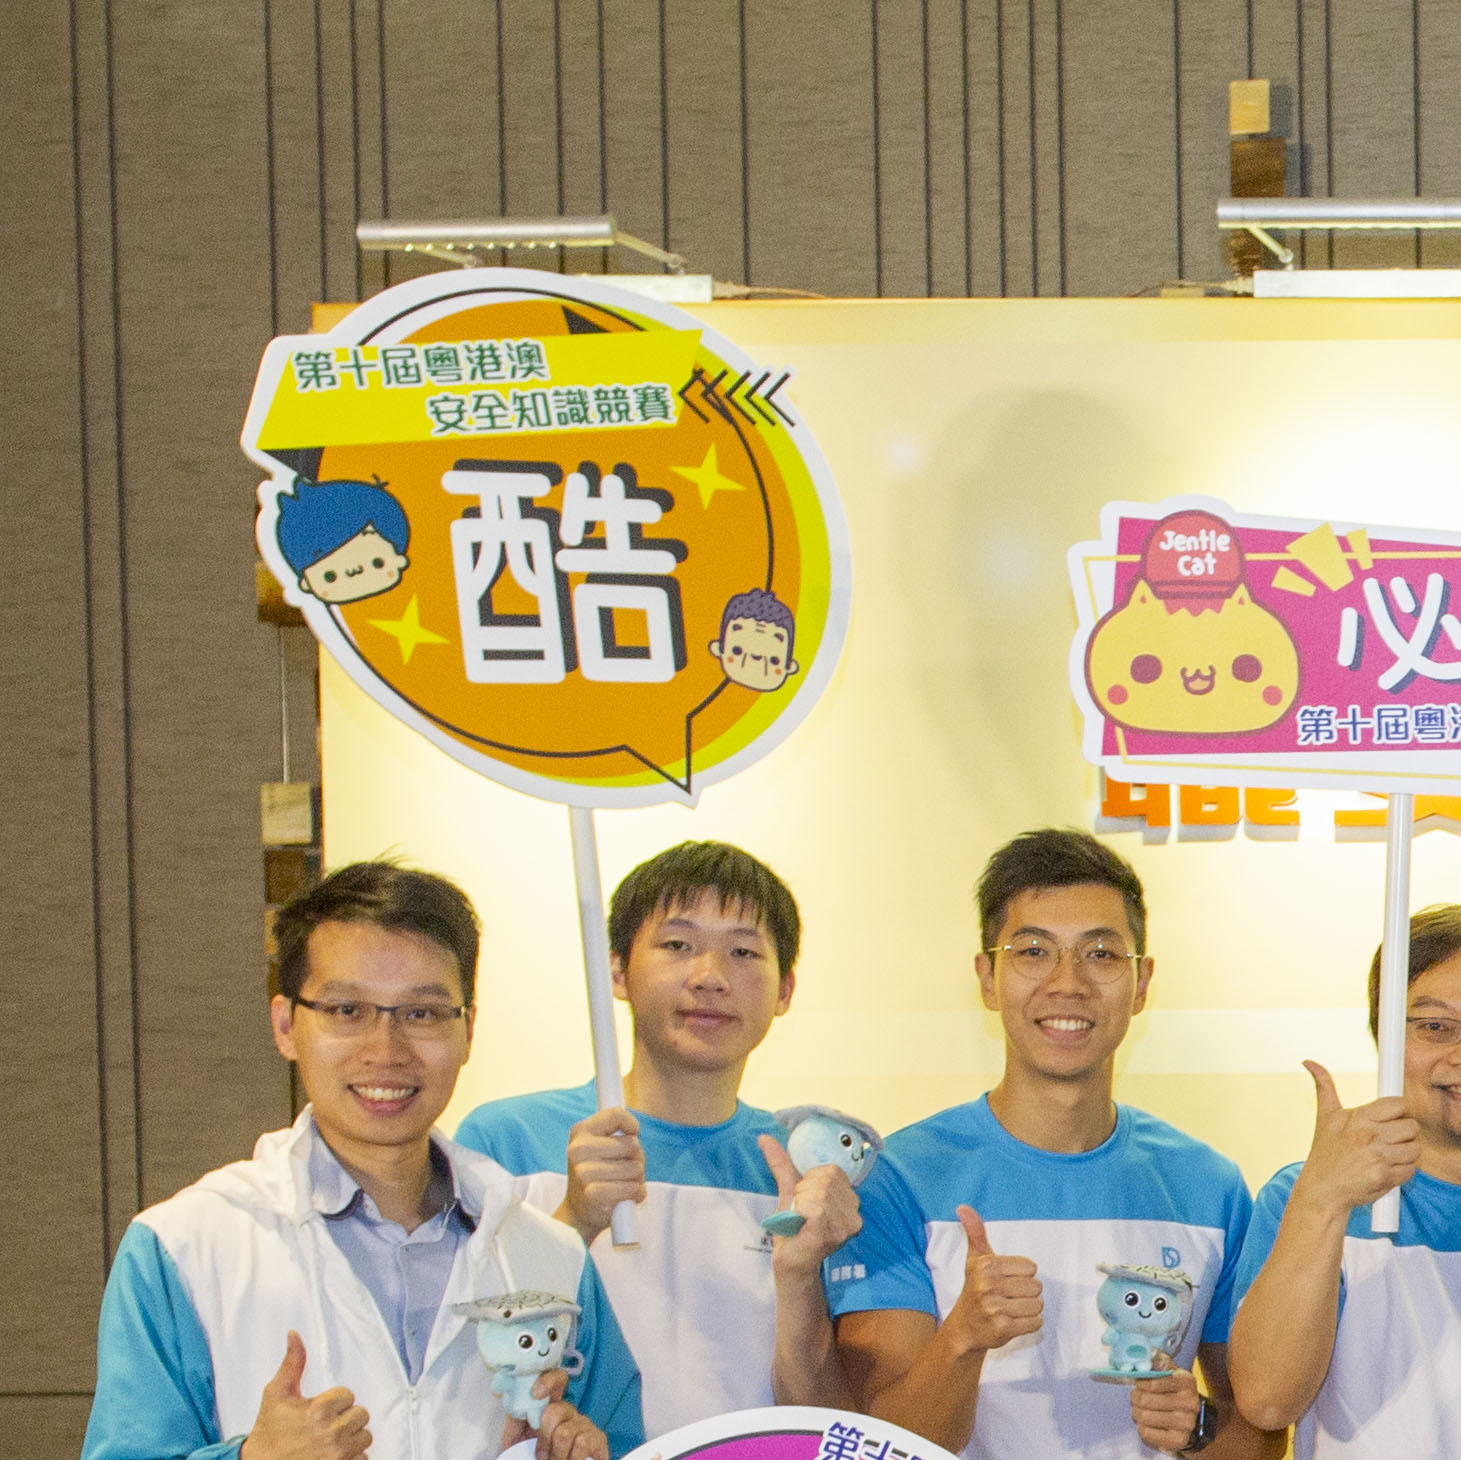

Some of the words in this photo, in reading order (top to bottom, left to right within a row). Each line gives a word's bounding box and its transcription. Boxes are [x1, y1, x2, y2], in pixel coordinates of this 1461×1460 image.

[294, 340, 549, 391] 第十屆粵港澳
[429, 384, 674, 434] 安全知識競賽
[1159, 528, 1232, 552] Jentle
[1177, 552, 1217, 577] Cat
[440, 468, 680, 685] 酷
